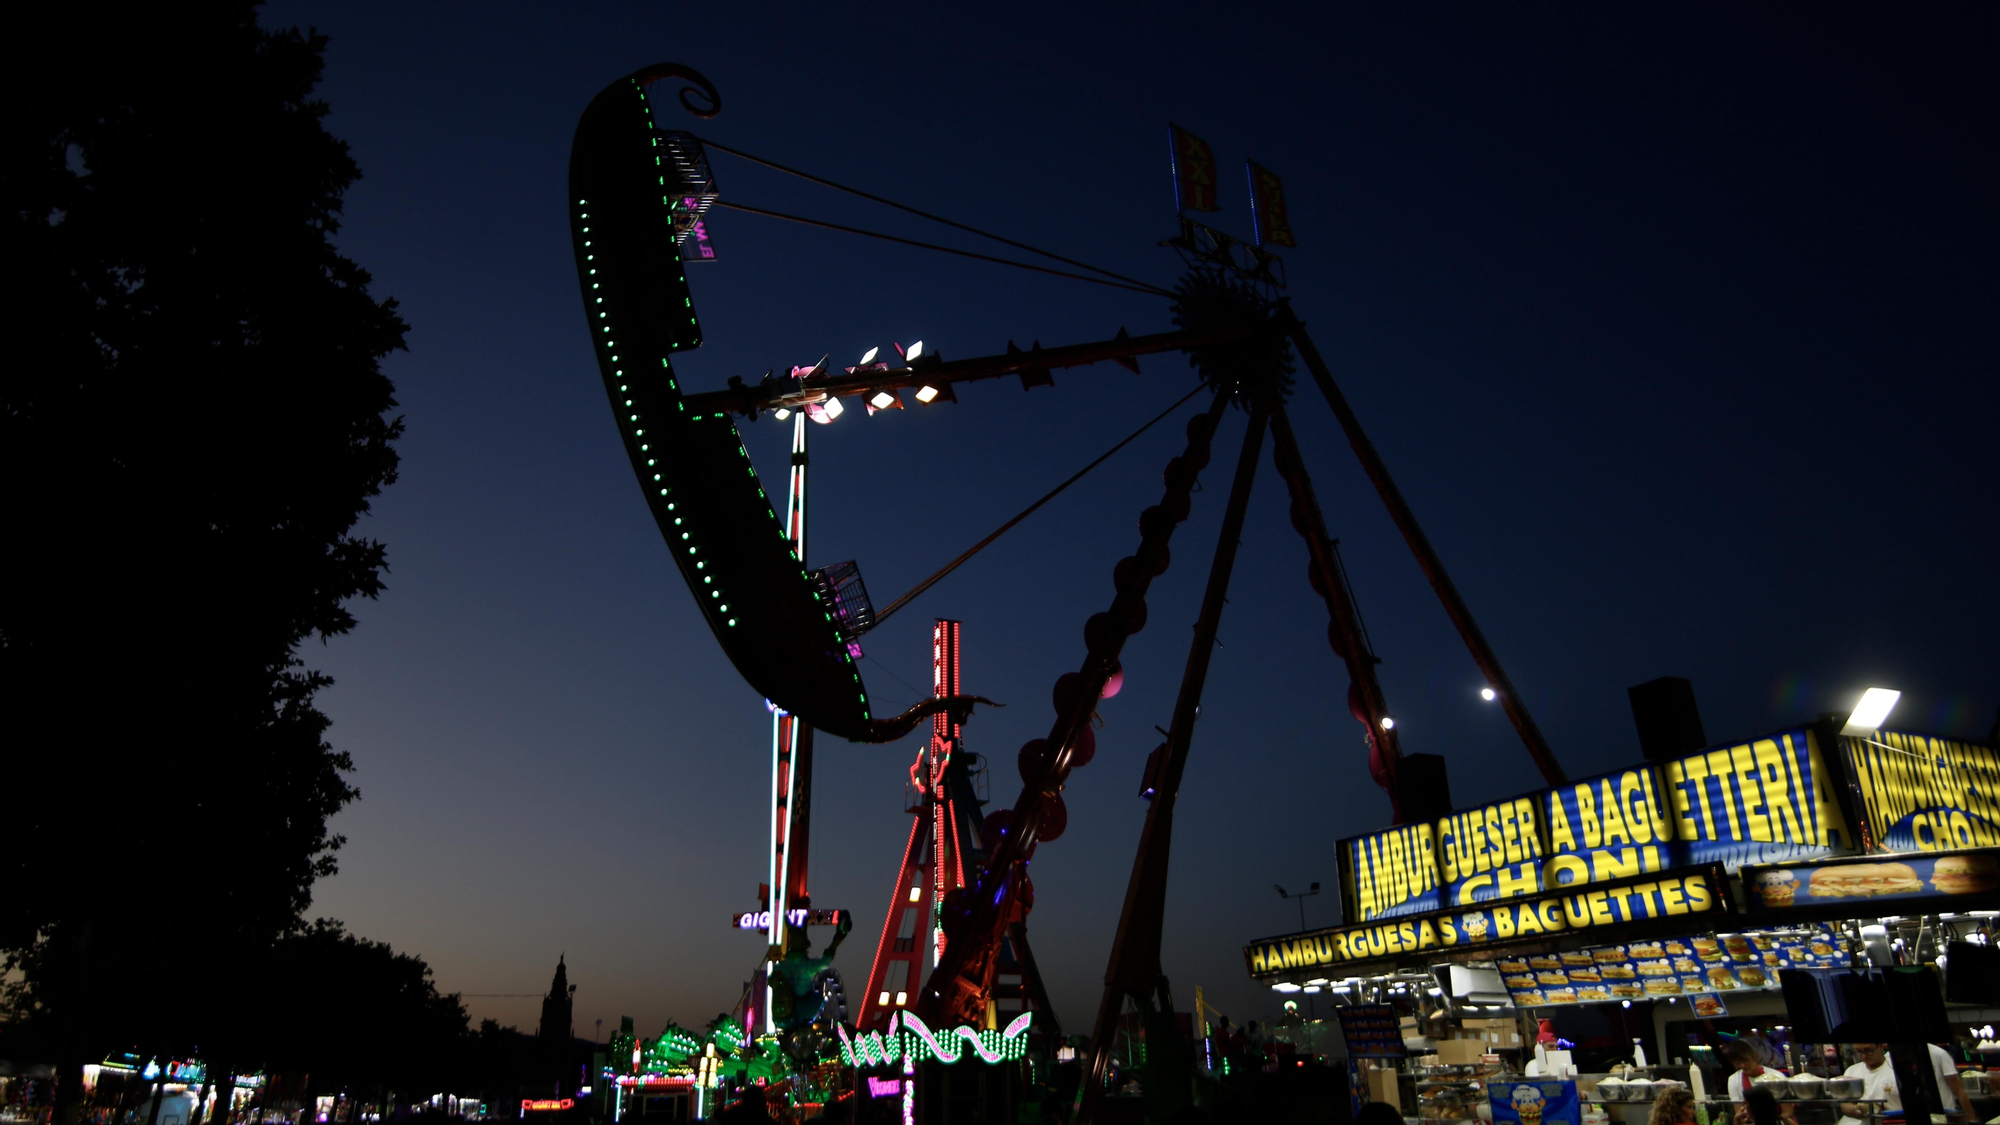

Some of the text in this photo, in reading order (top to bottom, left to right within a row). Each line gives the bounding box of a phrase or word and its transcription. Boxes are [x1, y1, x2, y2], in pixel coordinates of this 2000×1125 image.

[1850, 729, 2000, 849] HAMBURGUESER
[1459, 846, 1660, 906] CHONI
[740, 909, 808, 930] GIGNT
[1250, 875, 1712, 973] HAMBURGUESAS BAGUETTES
